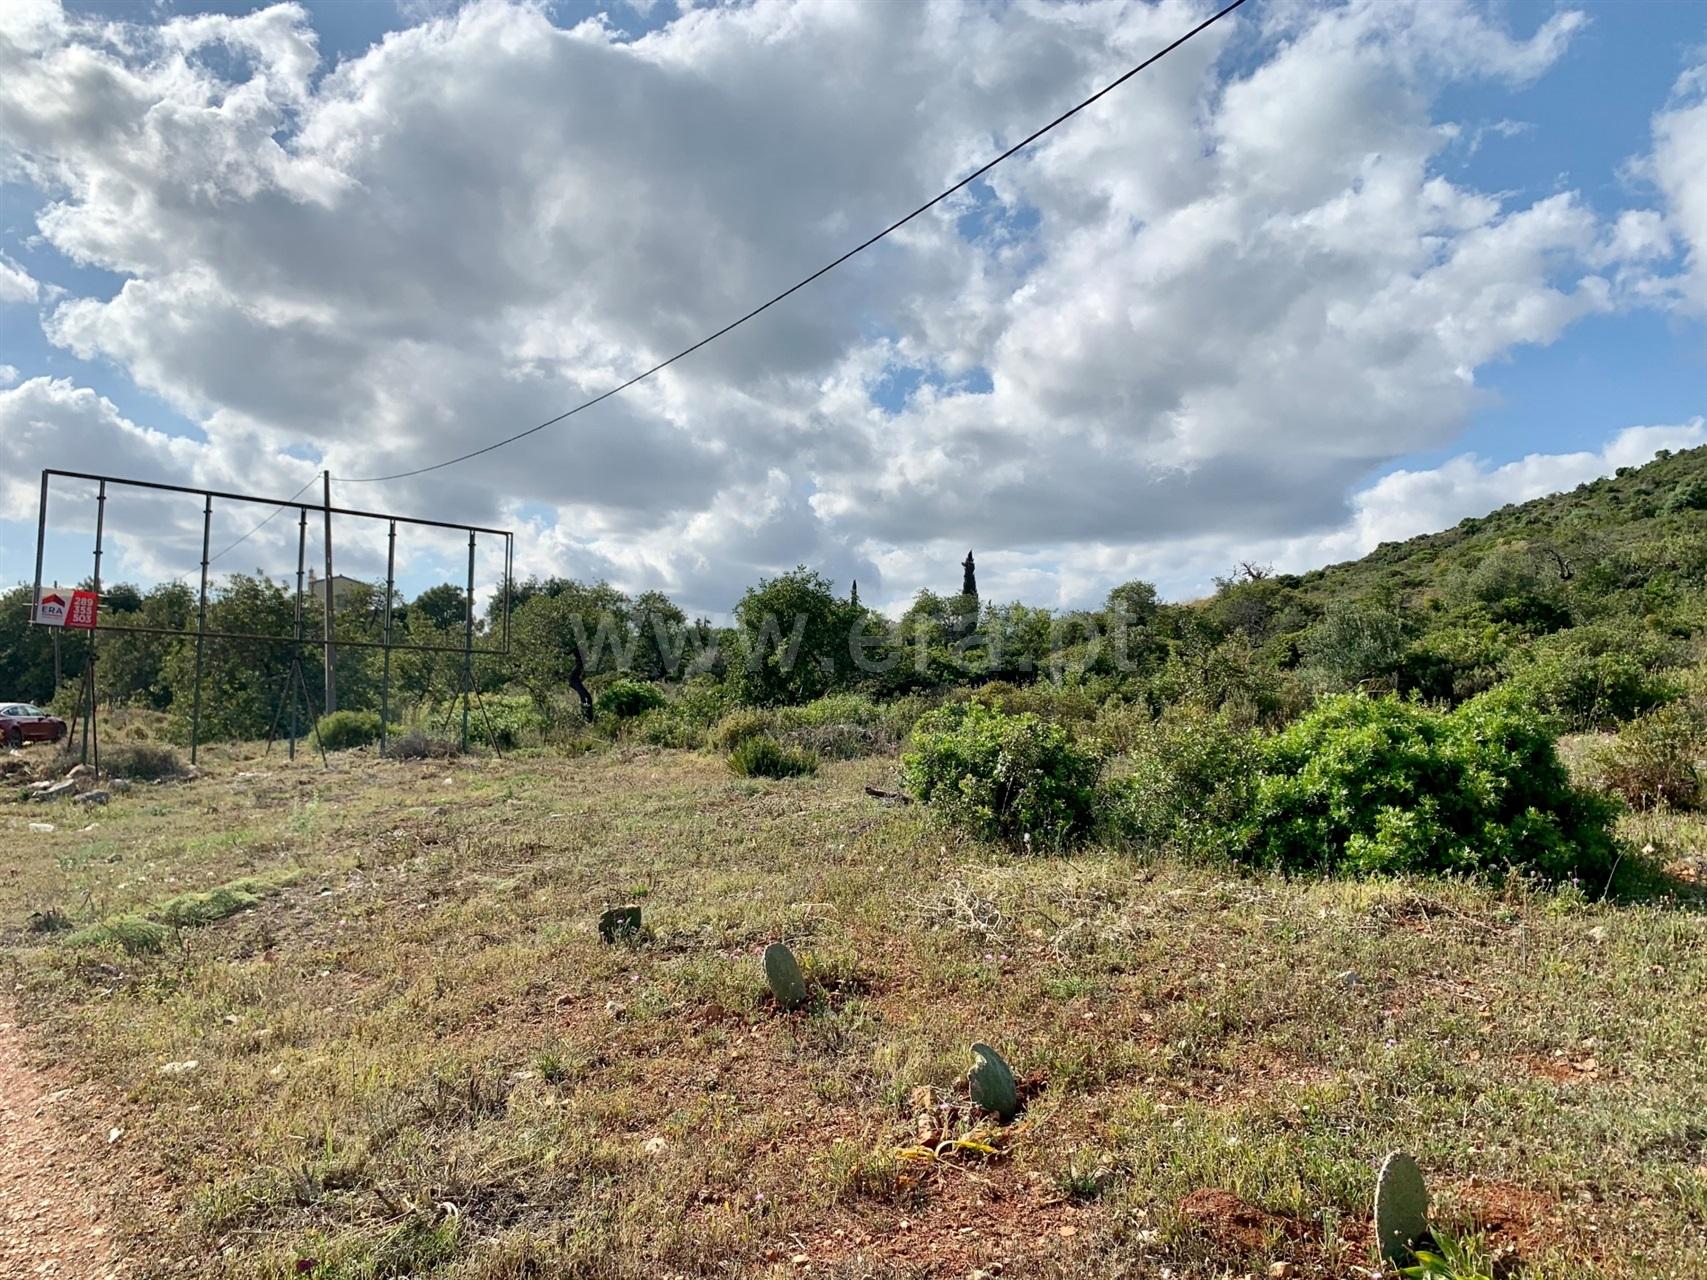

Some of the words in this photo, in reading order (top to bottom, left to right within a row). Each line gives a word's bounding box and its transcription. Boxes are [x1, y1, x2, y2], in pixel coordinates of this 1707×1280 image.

[74, 597, 94, 605] 289
[41, 606, 63, 615] ERA
[73, 605, 92, 614] 355
[72, 614, 91, 623] 503
